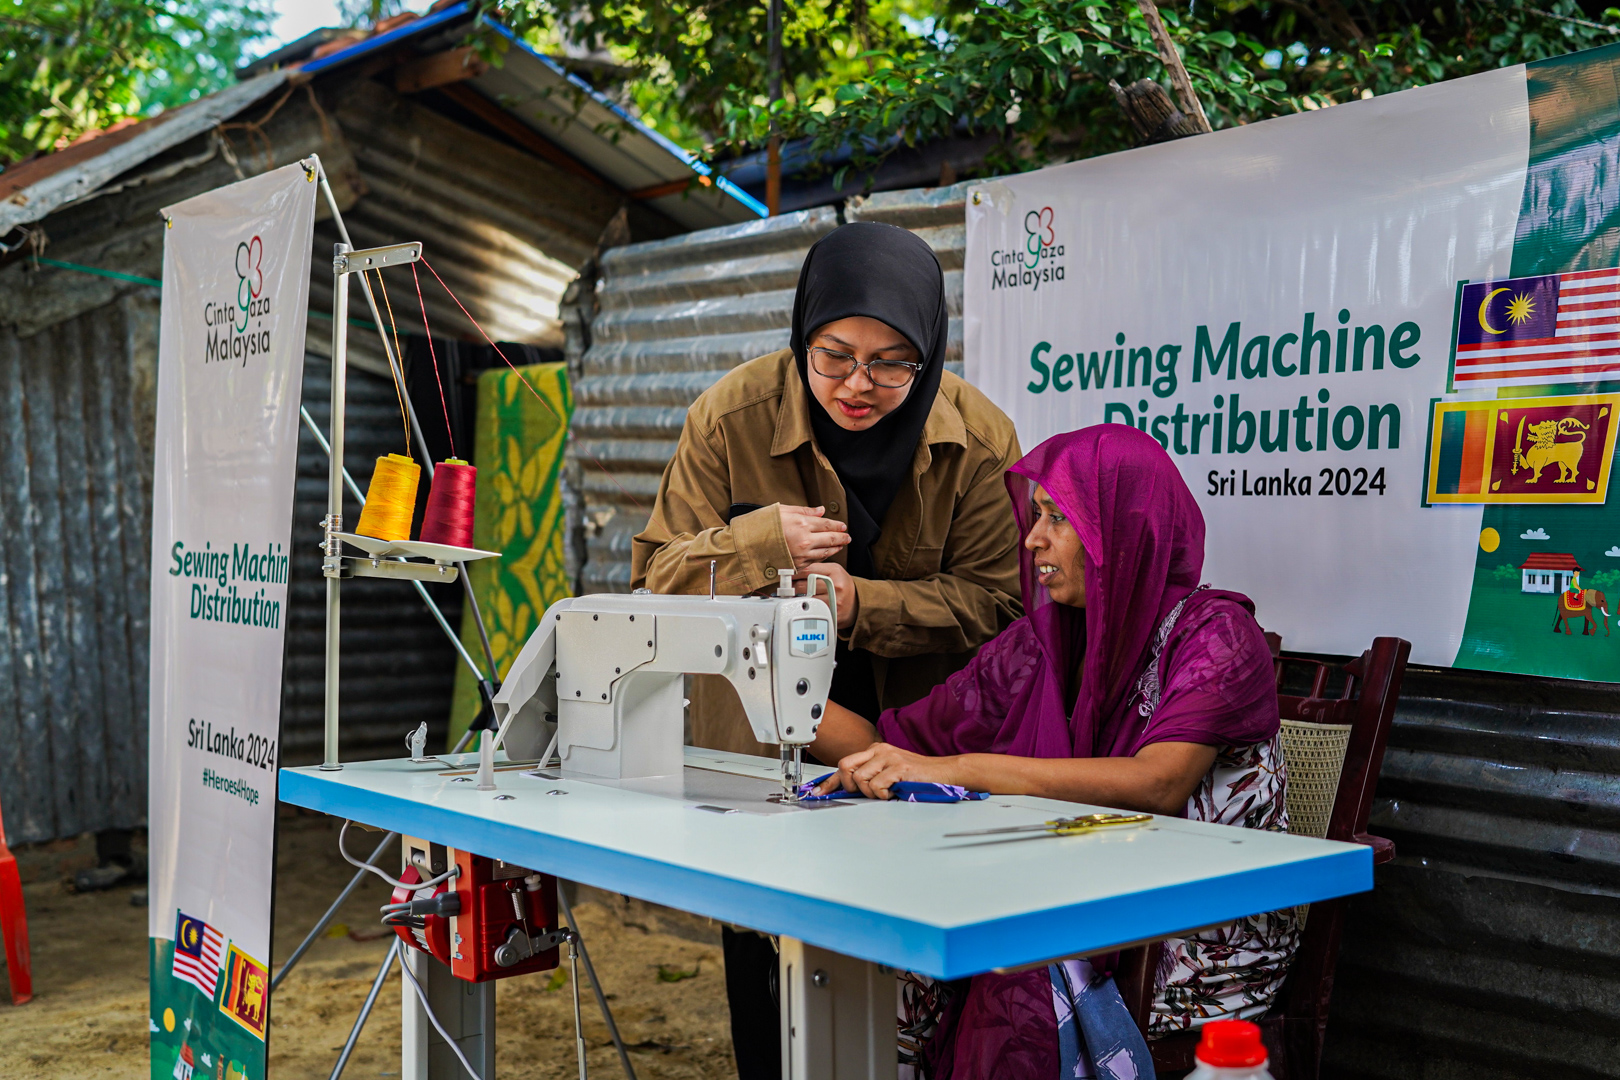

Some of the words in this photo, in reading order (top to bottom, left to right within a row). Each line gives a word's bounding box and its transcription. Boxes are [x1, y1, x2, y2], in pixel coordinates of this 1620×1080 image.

[991, 250, 1024, 267] Cinta
[992, 260, 1065, 291] Malaysia
[204, 302, 235, 327] Cinta
[205, 321, 270, 368] Malaysia
[1027, 332, 1182, 398] Sewing
[1191, 308, 1421, 383] Machine
[1207, 469, 1235, 497] Sri
[1241, 468, 1311, 497] Lanka
[1318, 466, 1387, 496] 2024
[168, 541, 229, 588] Sewing
[231, 542, 288, 584] Machin
[190, 583, 280, 629] Distribution
[187, 717, 204, 751] Sri
[206, 722, 244, 762] Lanka
[246, 732, 276, 773] 2024
[202, 767, 259, 807] #Heroes4Hope
